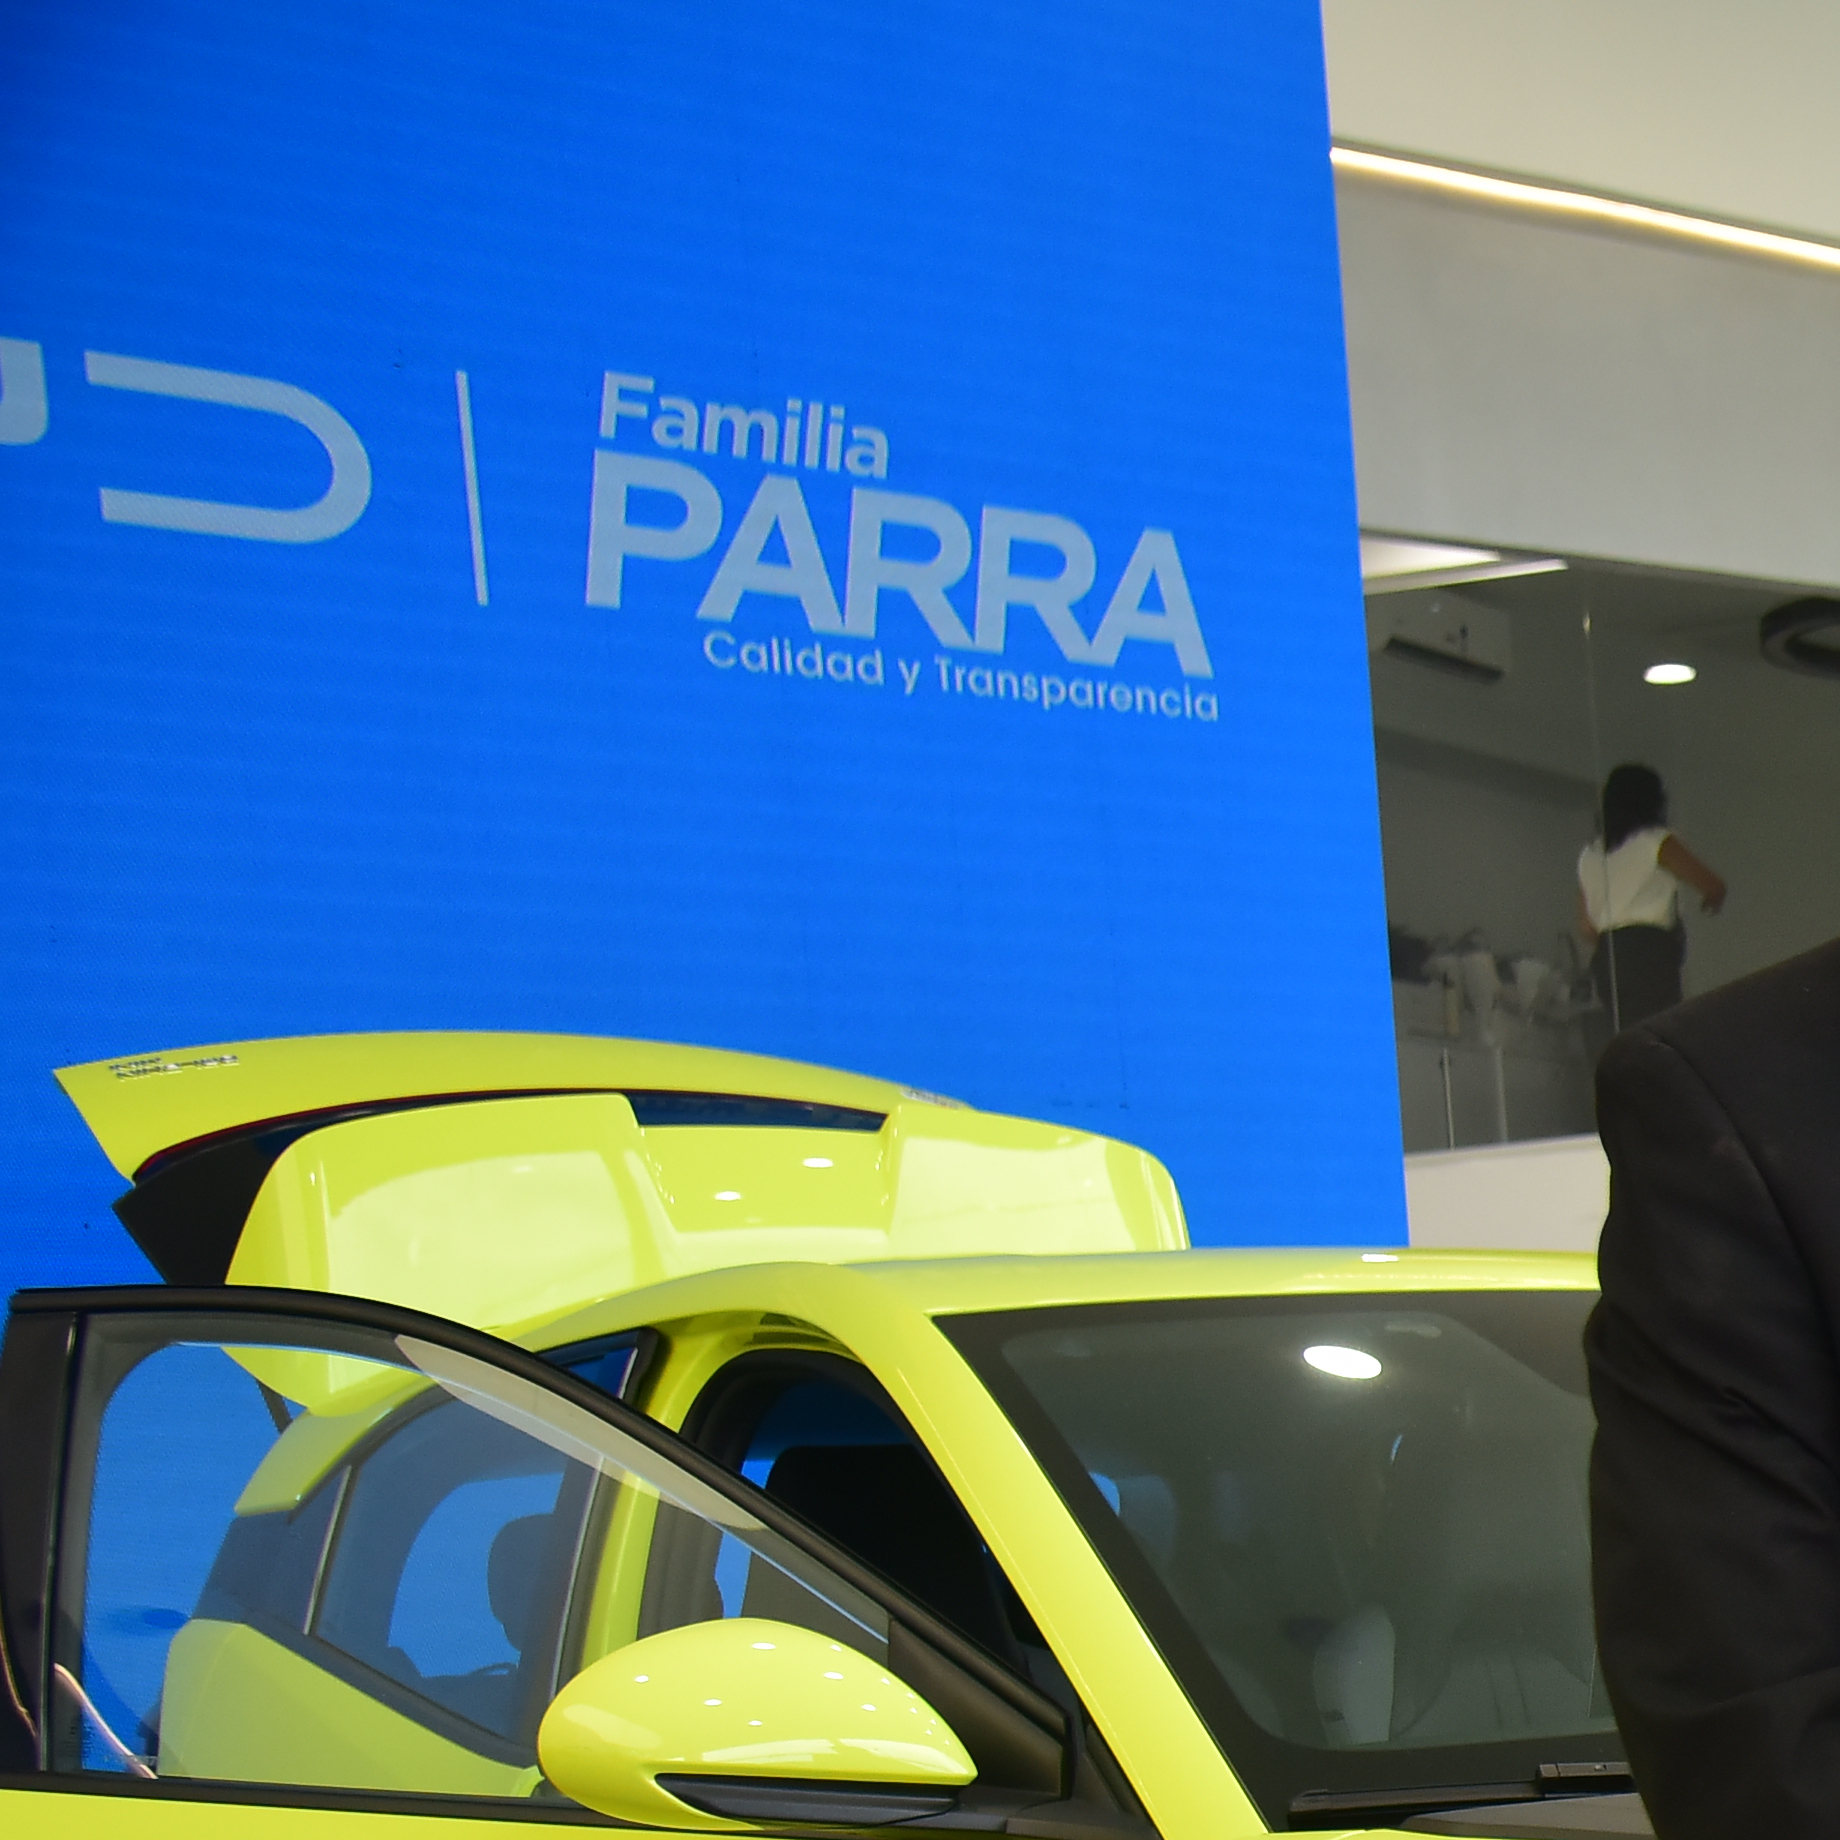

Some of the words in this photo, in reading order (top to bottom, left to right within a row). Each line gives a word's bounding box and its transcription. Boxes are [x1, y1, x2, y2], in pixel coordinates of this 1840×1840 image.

[600, 370, 889, 479] Familia
[586, 448, 1213, 679] PARRA
[703, 630, 884, 685] Calidad
[899, 659, 921, 695] y
[934, 656, 1219, 722] Transparencia
